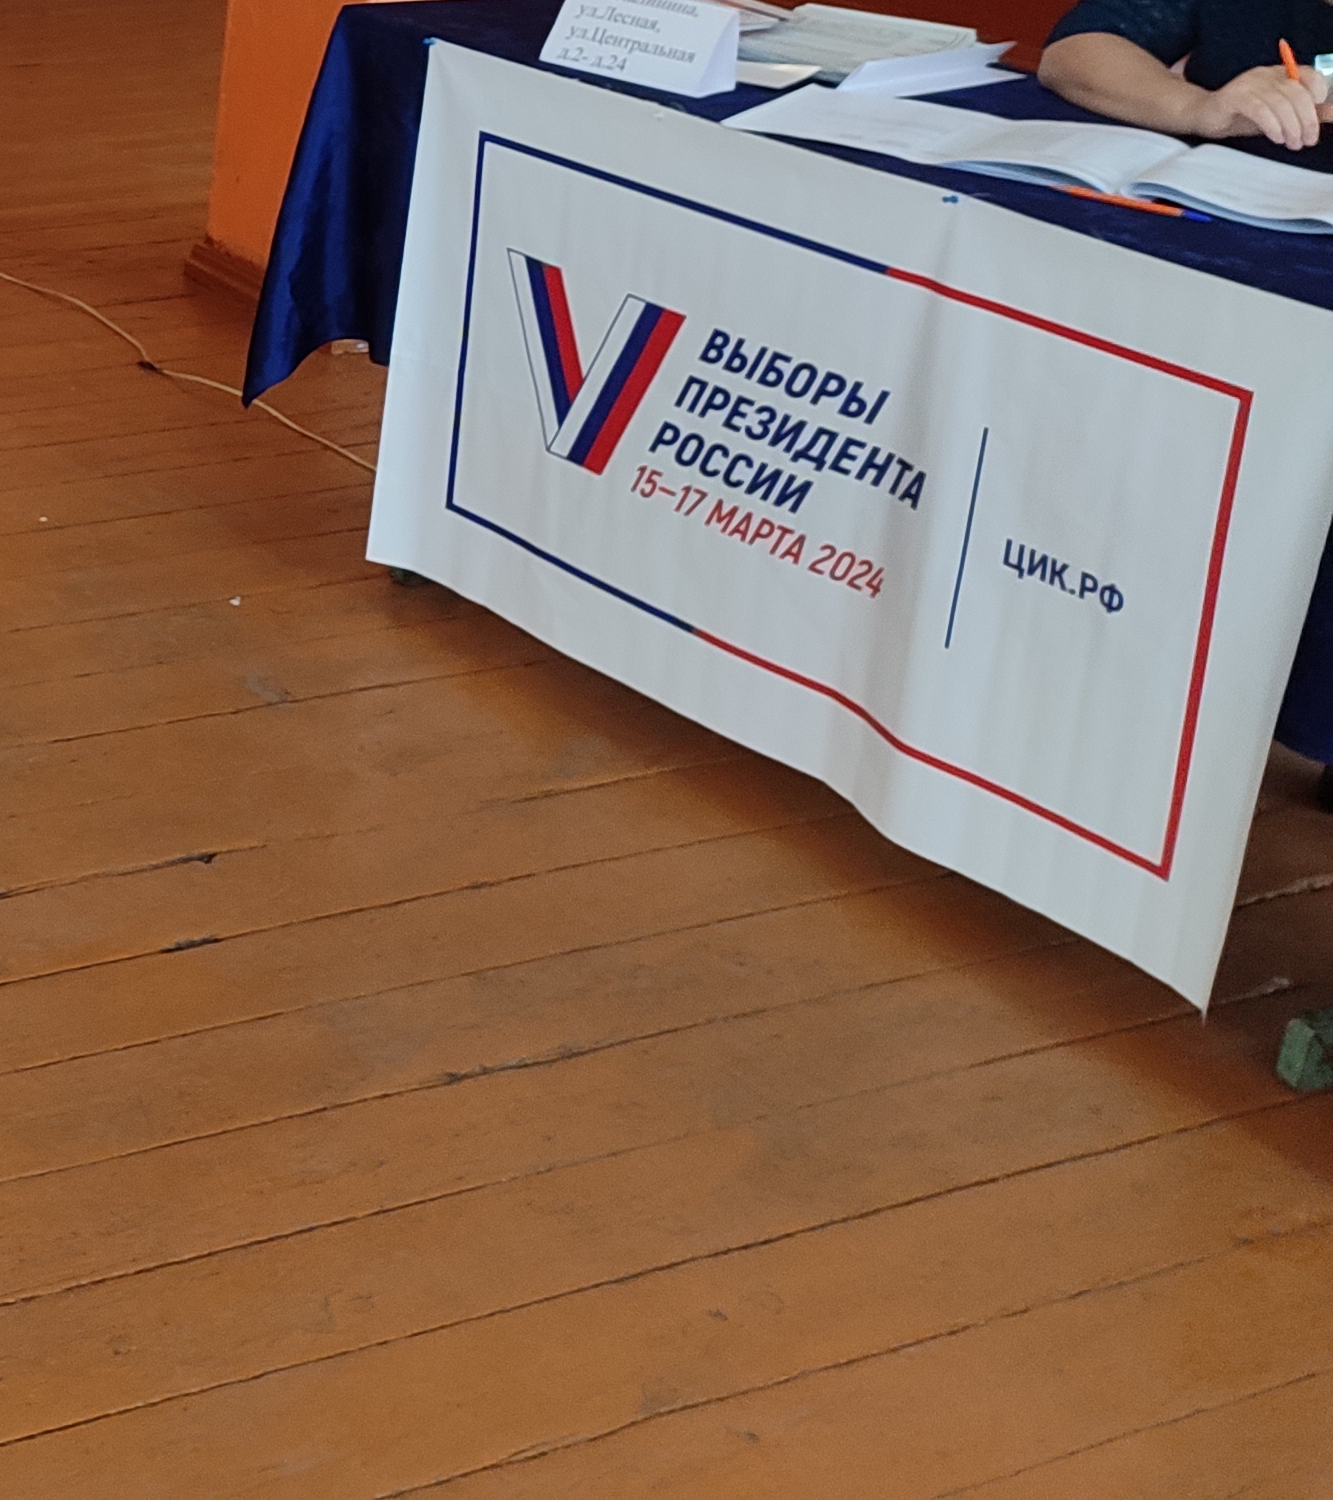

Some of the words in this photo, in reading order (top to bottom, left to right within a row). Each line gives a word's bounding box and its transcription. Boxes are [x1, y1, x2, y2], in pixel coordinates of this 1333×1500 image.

[565, 24, 696, 64] ул.Центральная
[698, 328, 891, 425] ВЫБОРЫ
[648, 421, 814, 514] РОССИИ
[674, 375, 927, 511] ПРЕЗИДЕНТА
[630, 465, 708, 517] 15–17
[704, 498, 807, 566] МАРТА
[808, 543, 885, 599] 2024
[1002, 538, 1125, 614] ЦИК.РФ
